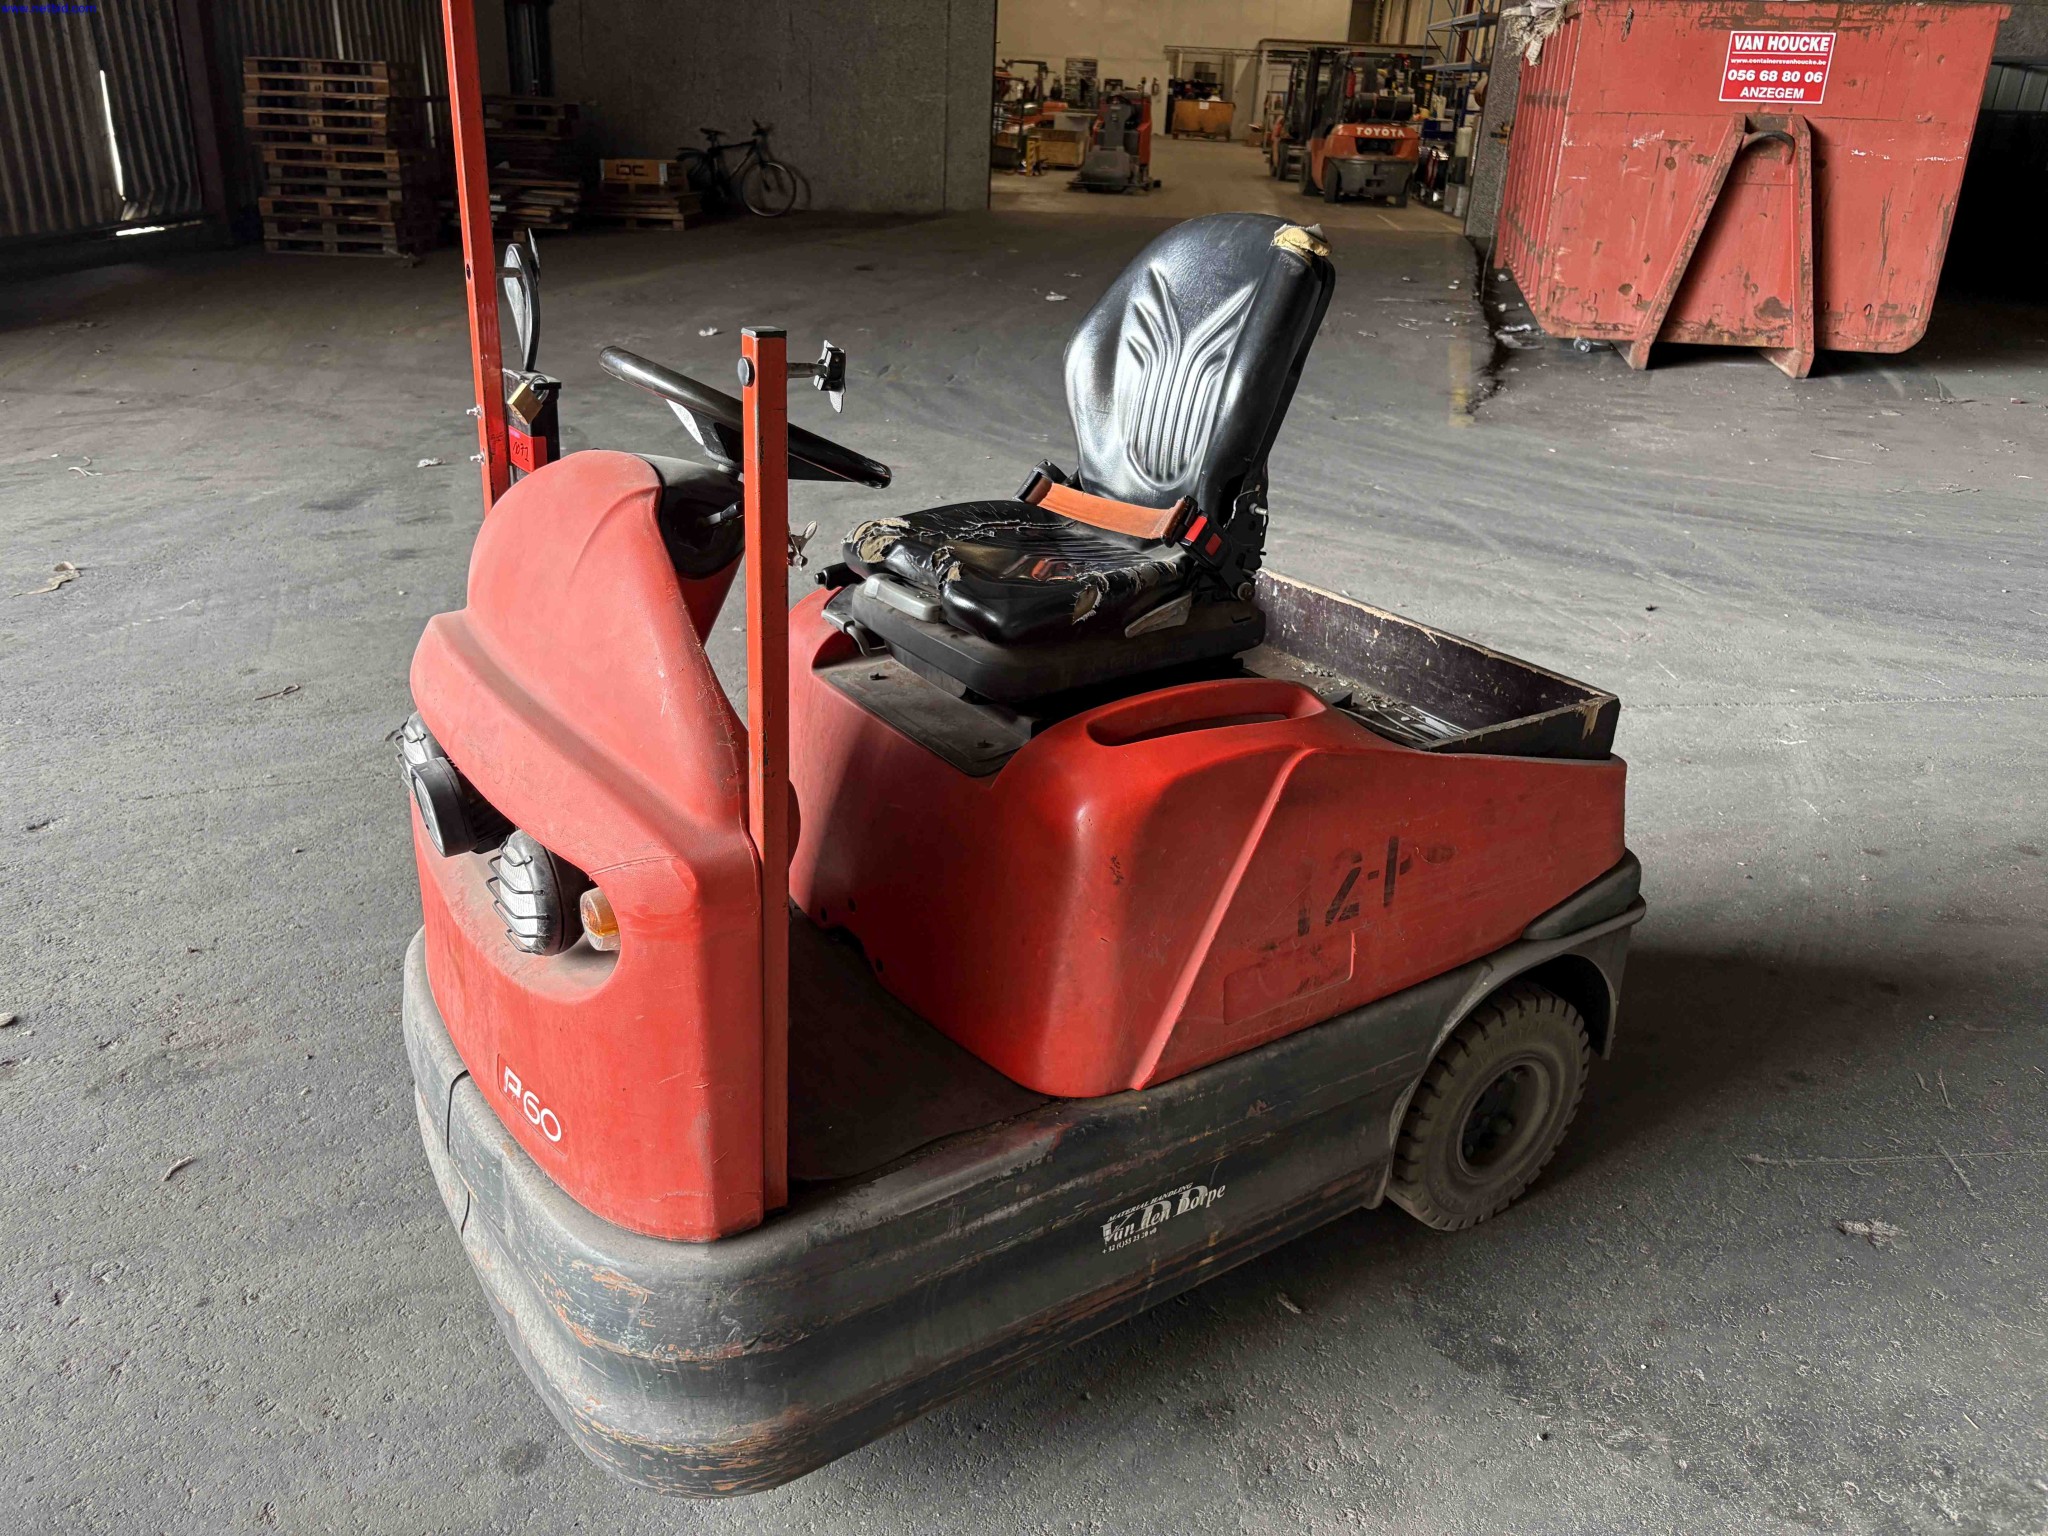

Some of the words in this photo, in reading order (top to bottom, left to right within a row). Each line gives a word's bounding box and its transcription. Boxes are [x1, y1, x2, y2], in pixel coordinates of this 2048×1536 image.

[1734, 35, 1764, 50] VAN
[1767, 35, 1830, 52] HOUCKE
[1727, 69, 1755, 81] 056
[1759, 70, 1778, 81] 68
[1782, 70, 1800, 82] 80
[1804, 71, 1823, 83] 06
[1740, 86, 1804, 99] ANZEGEM
[1356, 127, 1405, 138] TOYOTA
[503, 1065, 562, 1142] P60
